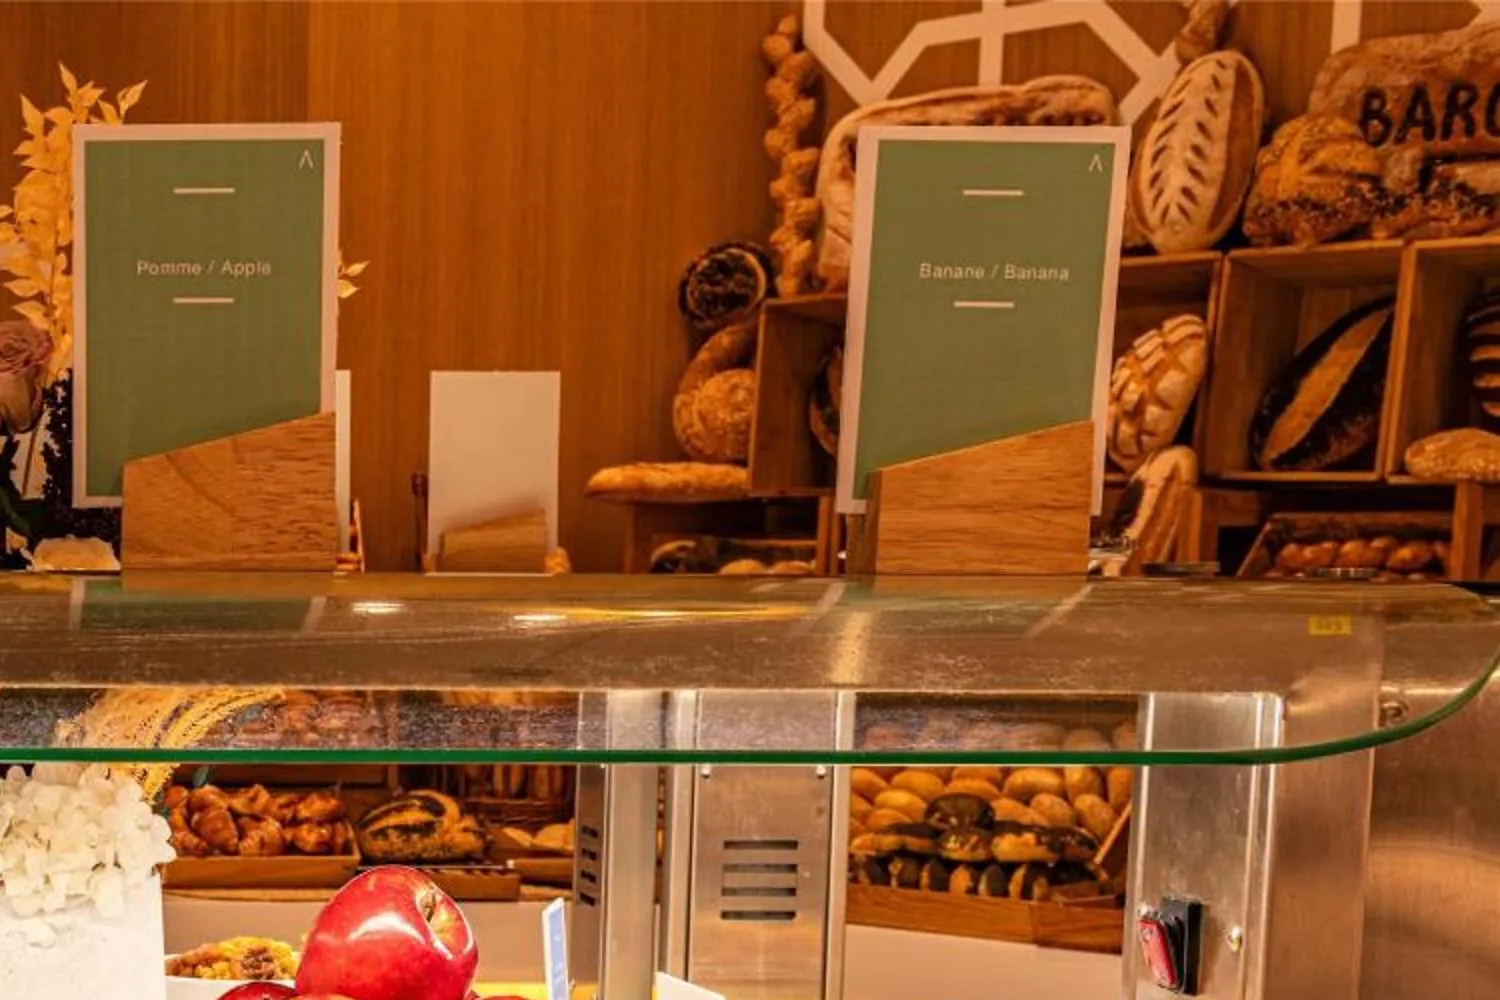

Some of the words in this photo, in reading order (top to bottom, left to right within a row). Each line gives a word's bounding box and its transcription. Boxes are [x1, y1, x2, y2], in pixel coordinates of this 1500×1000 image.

[136, 260, 202, 276] Pomme
[220, 259, 272, 278] Apple
[918, 262, 985, 279] Banane
[1004, 262, 1070, 281] Banana
